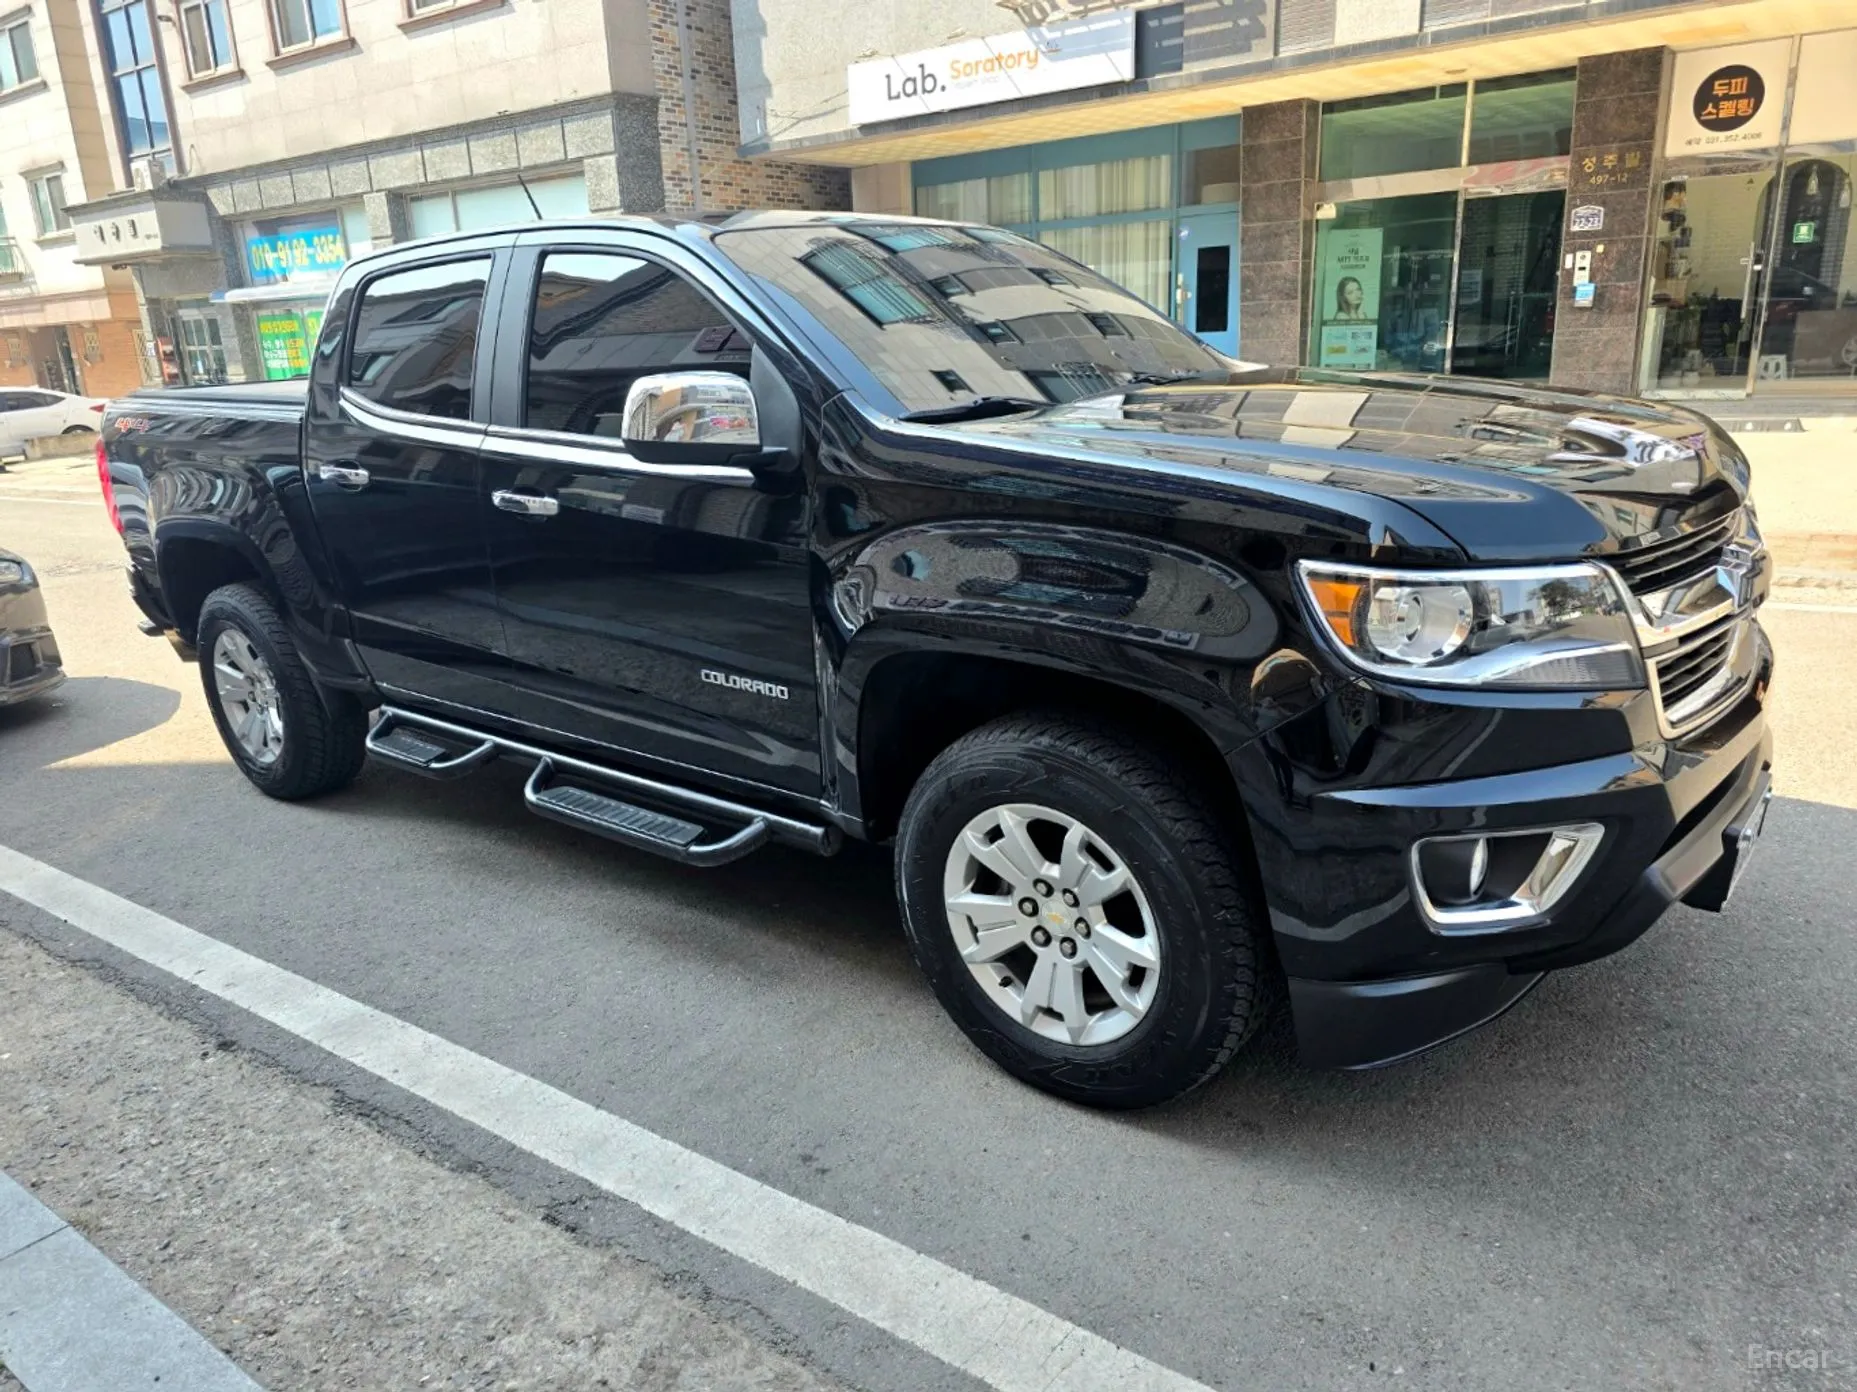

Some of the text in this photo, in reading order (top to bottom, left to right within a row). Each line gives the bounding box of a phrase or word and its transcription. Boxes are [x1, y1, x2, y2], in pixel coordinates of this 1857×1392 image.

[884, 48, 1039, 101] Lab. Soratory
[1713, 76, 1748, 96] 두피
[701, 669, 789, 700] COLORADO
